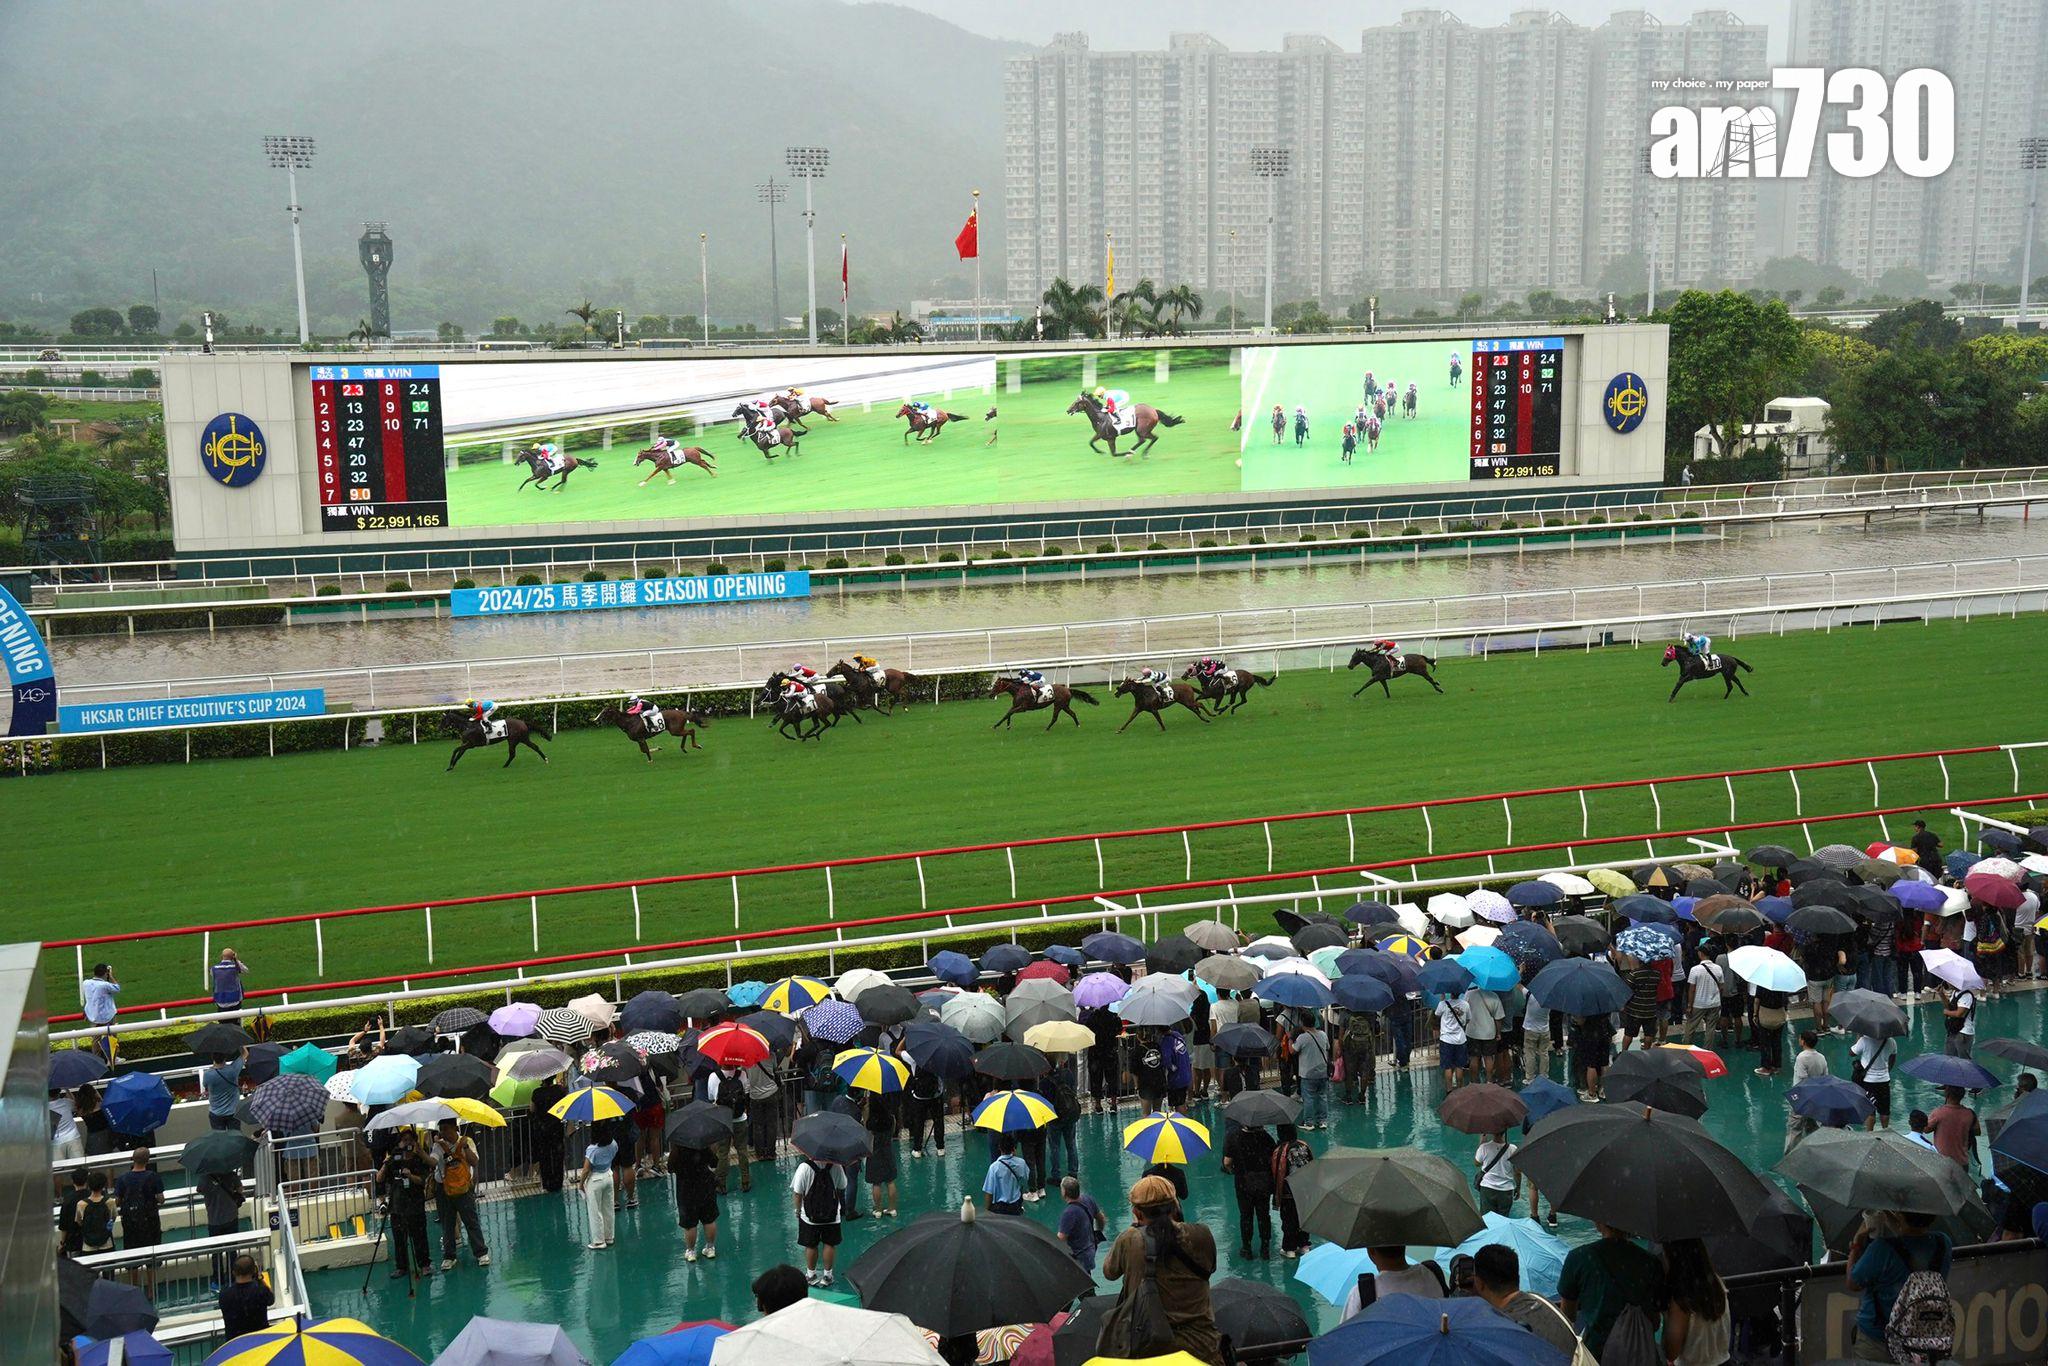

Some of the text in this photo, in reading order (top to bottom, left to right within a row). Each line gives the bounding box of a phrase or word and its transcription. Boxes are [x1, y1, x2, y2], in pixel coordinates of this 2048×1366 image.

[1527, 340, 1544, 350] WIN
[1477, 354, 1555, 366] 1 2.3 8 2.4
[388, 368, 412, 378] WIN
[1476, 368, 1554, 381] 2 13 9 32
[320, 384, 430, 396] 1 2.3 8 2.4
[1476, 383, 1552, 396] 3 23 10 71
[320, 401, 429, 414] 2 13 9 32
[1475, 400, 1506, 410] 4 47
[322, 418, 428, 432] 3 23 10 71
[1475, 414, 1505, 425] 5 20
[1475, 429, 1505, 440] 6 32
[322, 438, 364, 449] 4 47
[1475, 444, 1506, 454] 7 9.0
[324, 454, 366, 466] 5 20
[1491, 458, 1508, 466] WIN
[325, 472, 368, 484] 6 32
[1494, 466, 1554, 478] $ 22,991,165
[326, 488, 370, 501] 7 9.0
[351, 505, 374, 516] WIN
[357, 514, 440, 530] $ 22,991,165
[478, 574, 786, 612] 2024/25 馬季開鑼 SEASON OPENING
[81, 696, 306, 725] HKSAR CHIEF EXECUTIVE'S CUP 2024
[658, 718, 664, 730] 8
